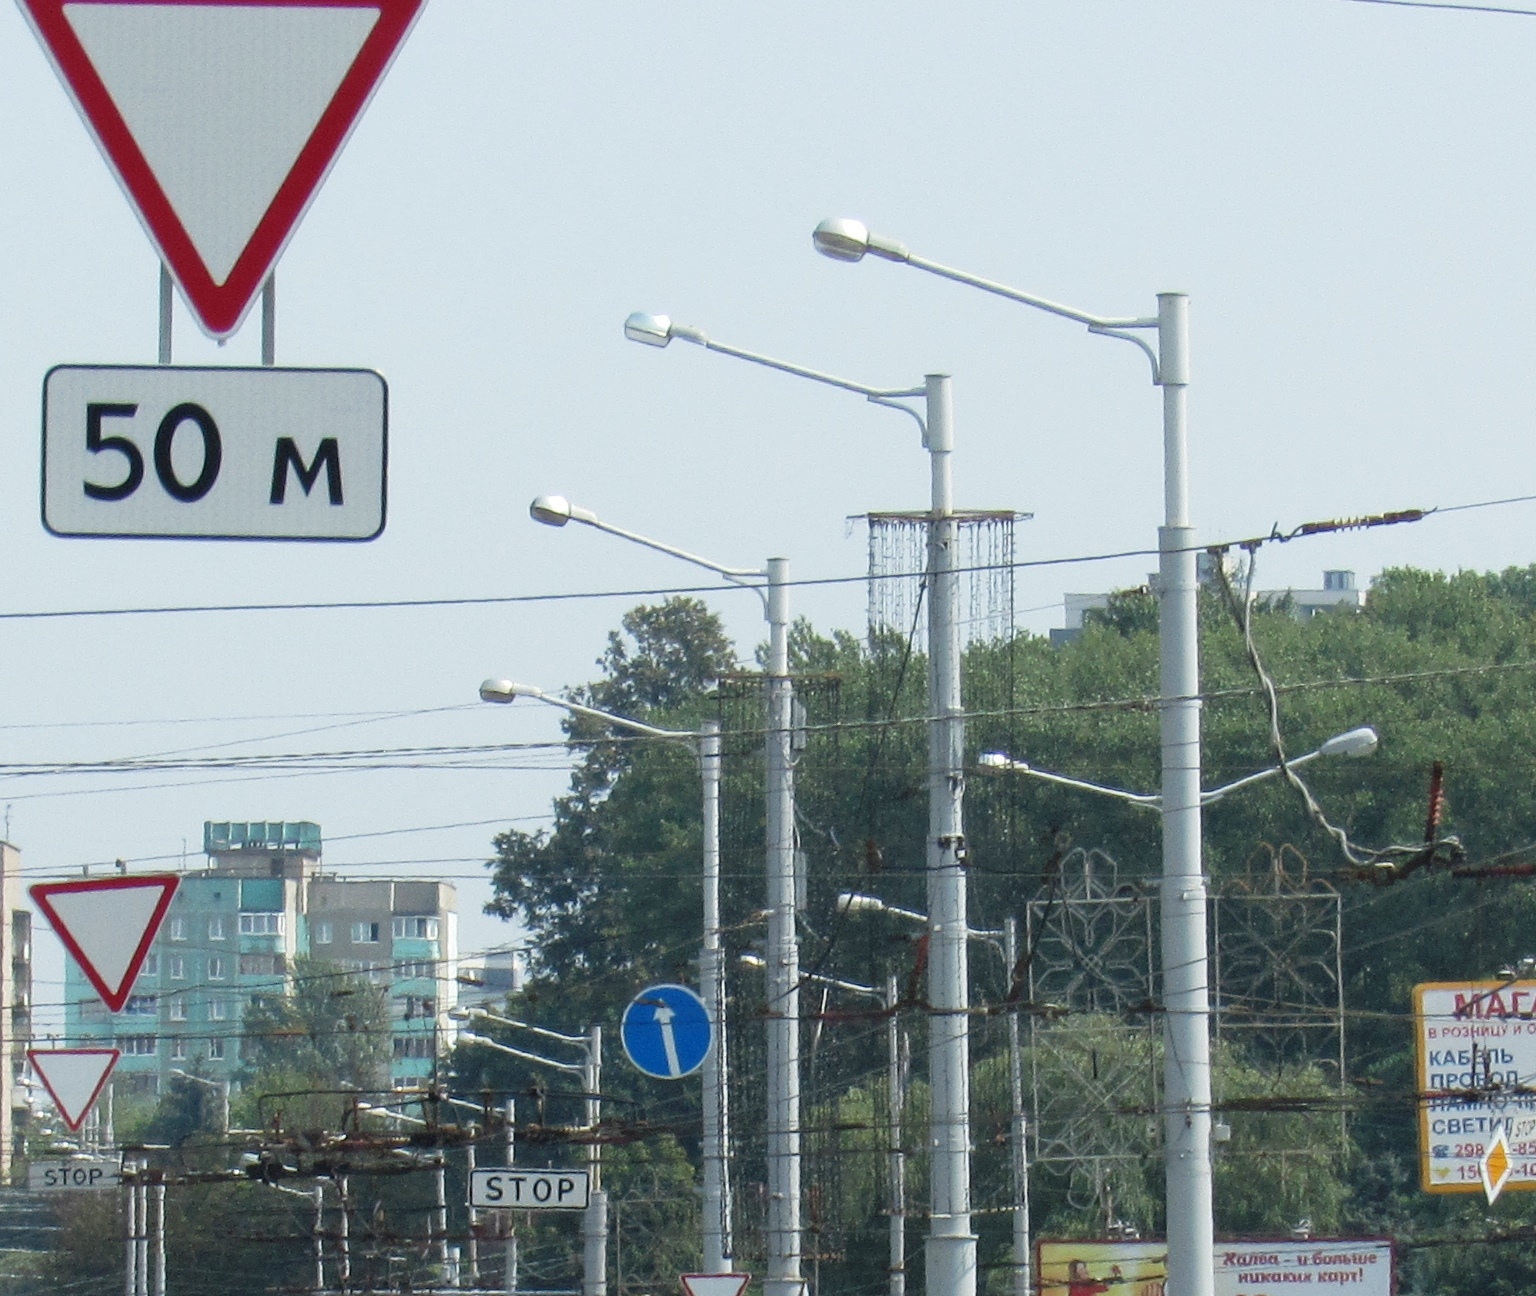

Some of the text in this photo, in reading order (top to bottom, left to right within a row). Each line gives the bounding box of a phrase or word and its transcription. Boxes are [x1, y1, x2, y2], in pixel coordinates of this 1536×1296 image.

[82, 401, 223, 503] 50
[1441, 1024, 1508, 1039] РОЗНИЦУ
[44, 1167, 104, 1187] STOP
[484, 1176, 575, 1202] STOP
[1222, 1251, 1280, 1267] Халва
[1310, 1250, 1378, 1266] больше
[1238, 1267, 1364, 1286] никаких карт!
